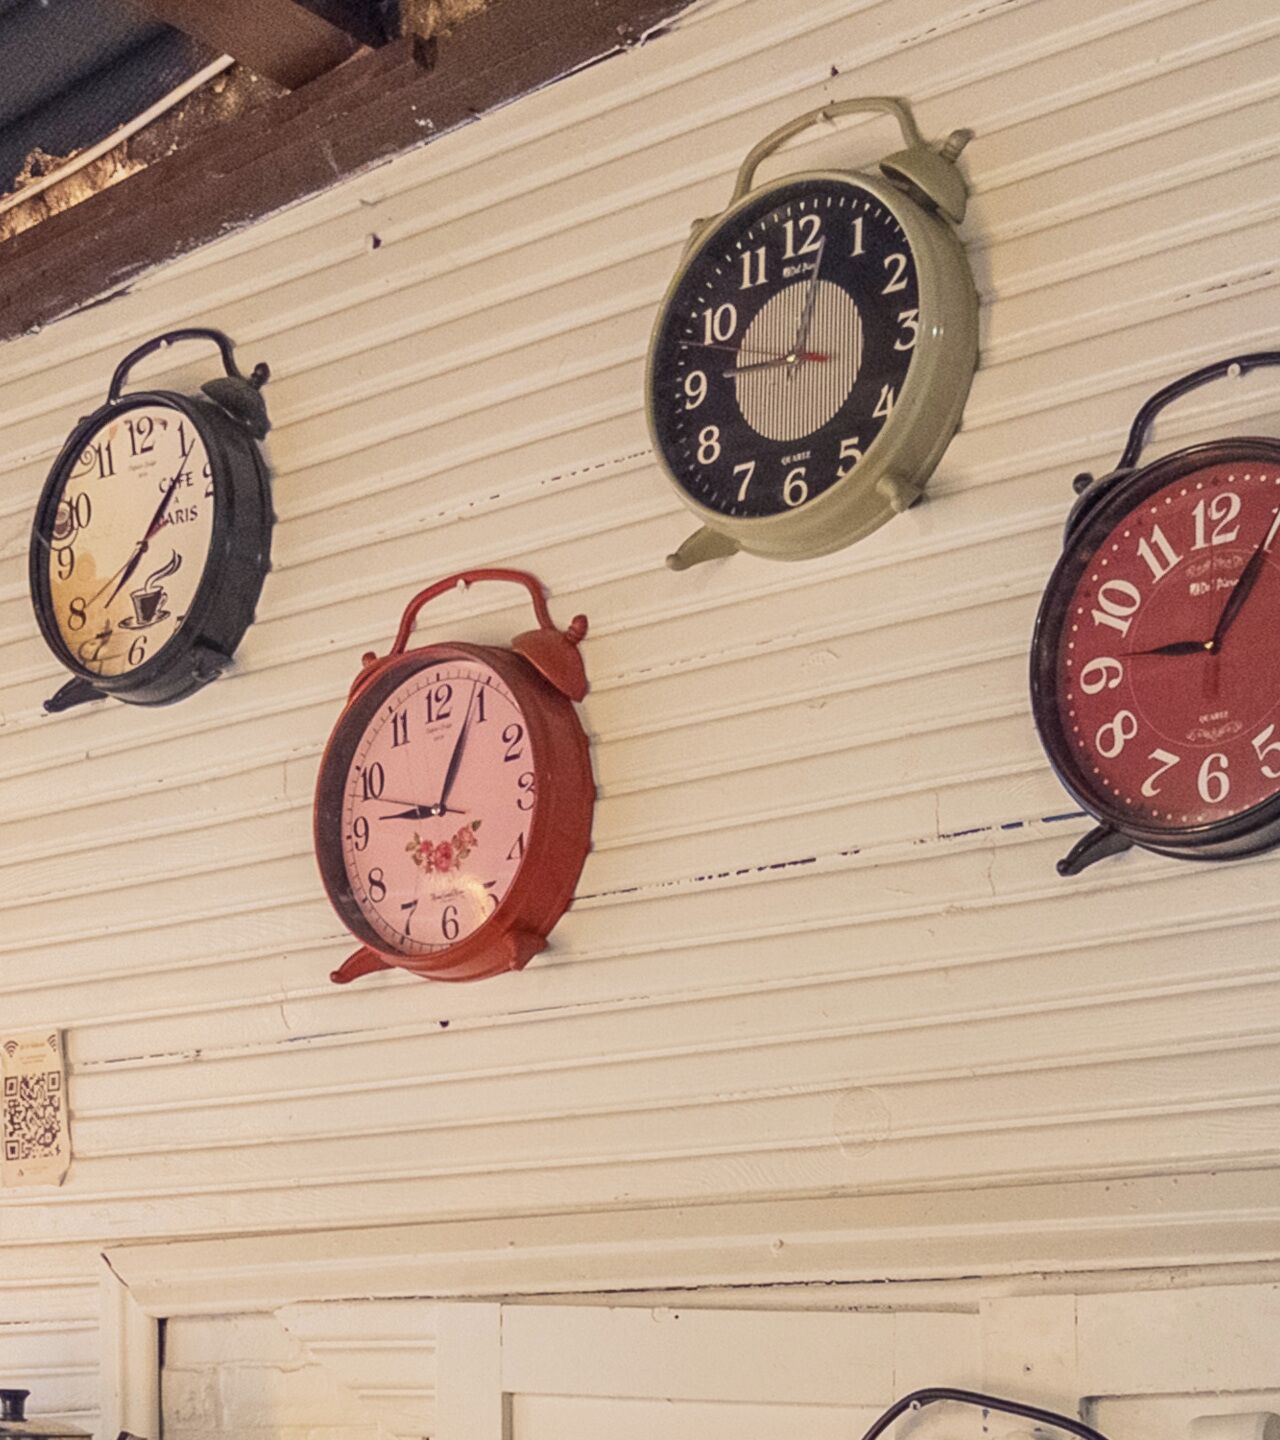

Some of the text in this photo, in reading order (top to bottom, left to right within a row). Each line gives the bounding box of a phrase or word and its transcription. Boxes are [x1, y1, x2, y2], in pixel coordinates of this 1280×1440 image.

[782, 214, 821, 260] 12
[850, 217, 866, 257] 1
[739, 247, 769, 290] 11
[881, 253, 908, 295] 2
[702, 303, 738, 346] 10
[894, 309, 919, 351] 3
[683, 371, 708, 410] 9
[872, 384, 894, 419] 4
[124, 416, 156, 457] 12
[178, 421, 188, 459] 1
[696, 425, 721, 466] 8
[96, 441, 116, 480] 11
[836, 437, 862, 478] 5
[733, 461, 756, 502] 7
[784, 467, 807, 506] 6
[68, 492, 91, 530] 10
[160, 505, 198, 527] ARIS
[1191, 492, 1241, 551] 12
[58, 546, 75, 580] 9
[1137, 524, 1183, 584] 11
[68, 596, 87, 631] 8
[1092, 579, 1141, 638] 10
[128, 635, 147, 666] 6
[1080, 656, 1123, 695] 9
[425, 683, 453, 724] 12
[476, 685, 487, 723] 1
[391, 709, 411, 748] 11
[502, 723, 523, 762] 2
[1095, 709, 1138, 758] 8
[361, 761, 384, 802] 10
[517, 772, 535, 811] 3
[1141, 748, 1181, 798] 7
[1197, 753, 1229, 803] 6
[353, 816, 369, 851] 9
[506, 832, 524, 861] 4
[368, 867, 386, 903] 8
[401, 900, 417, 935] 7
[442, 906, 459, 940] 6
